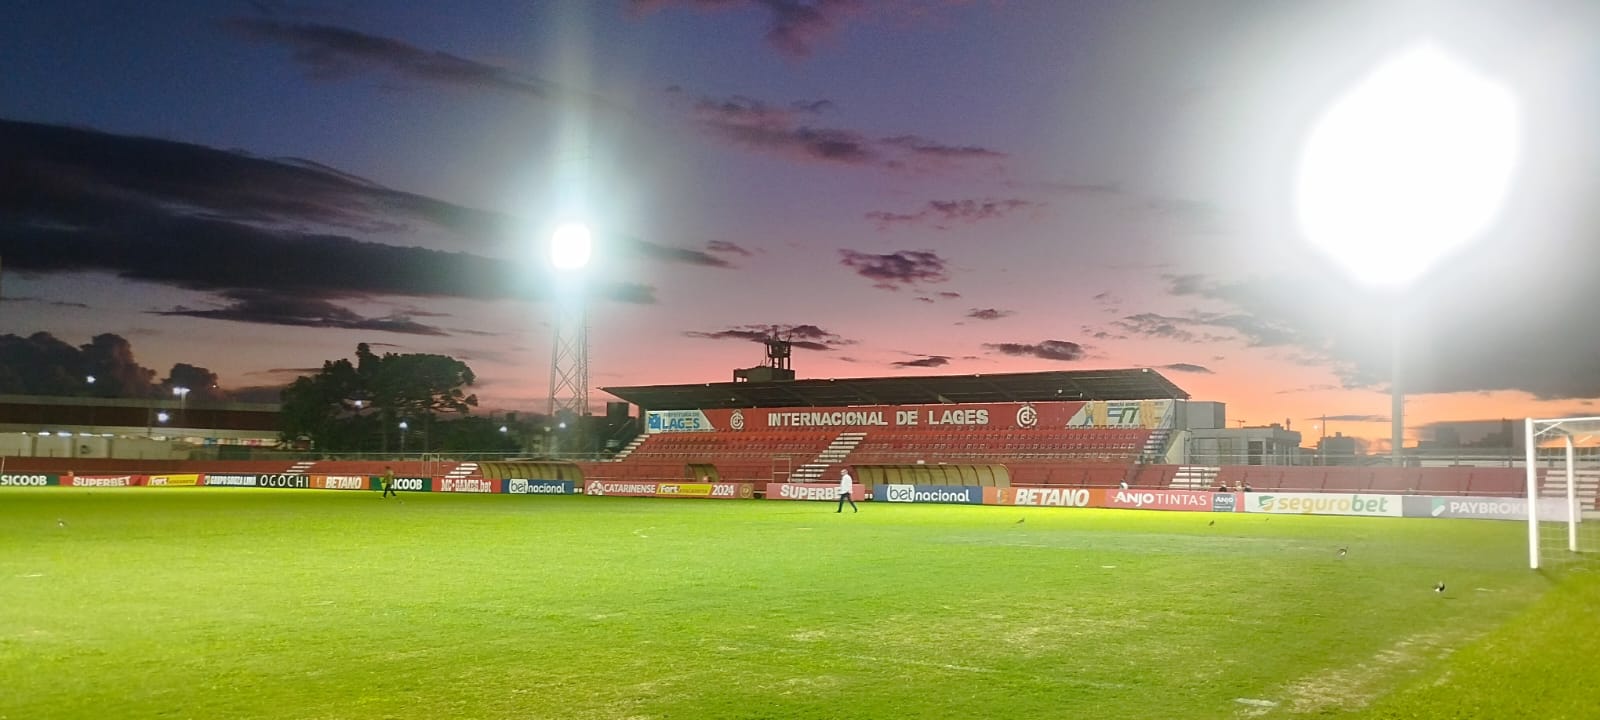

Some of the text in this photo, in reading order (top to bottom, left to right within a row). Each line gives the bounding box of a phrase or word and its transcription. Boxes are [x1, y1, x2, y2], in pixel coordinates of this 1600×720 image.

[662, 417, 701, 430] LAGES
[768, 409, 989, 427] INTERNACIONAL DE LAGES
[1, 474, 48, 486] SICOOB
[73, 475, 131, 487] SUPERBET
[260, 474, 309, 487] OGOCHI
[325, 476, 362, 489] BETANO
[509, 479, 565, 494] betnacional
[604, 483, 656, 494] CATARINENSE
[712, 485, 734, 496] 2024
[889, 485, 970, 502] betnacional
[1015, 489, 1089, 507] BETANO
[1112, 491, 1207, 507] ANJO TINTAS
[1279, 494, 1388, 514] segurobet
